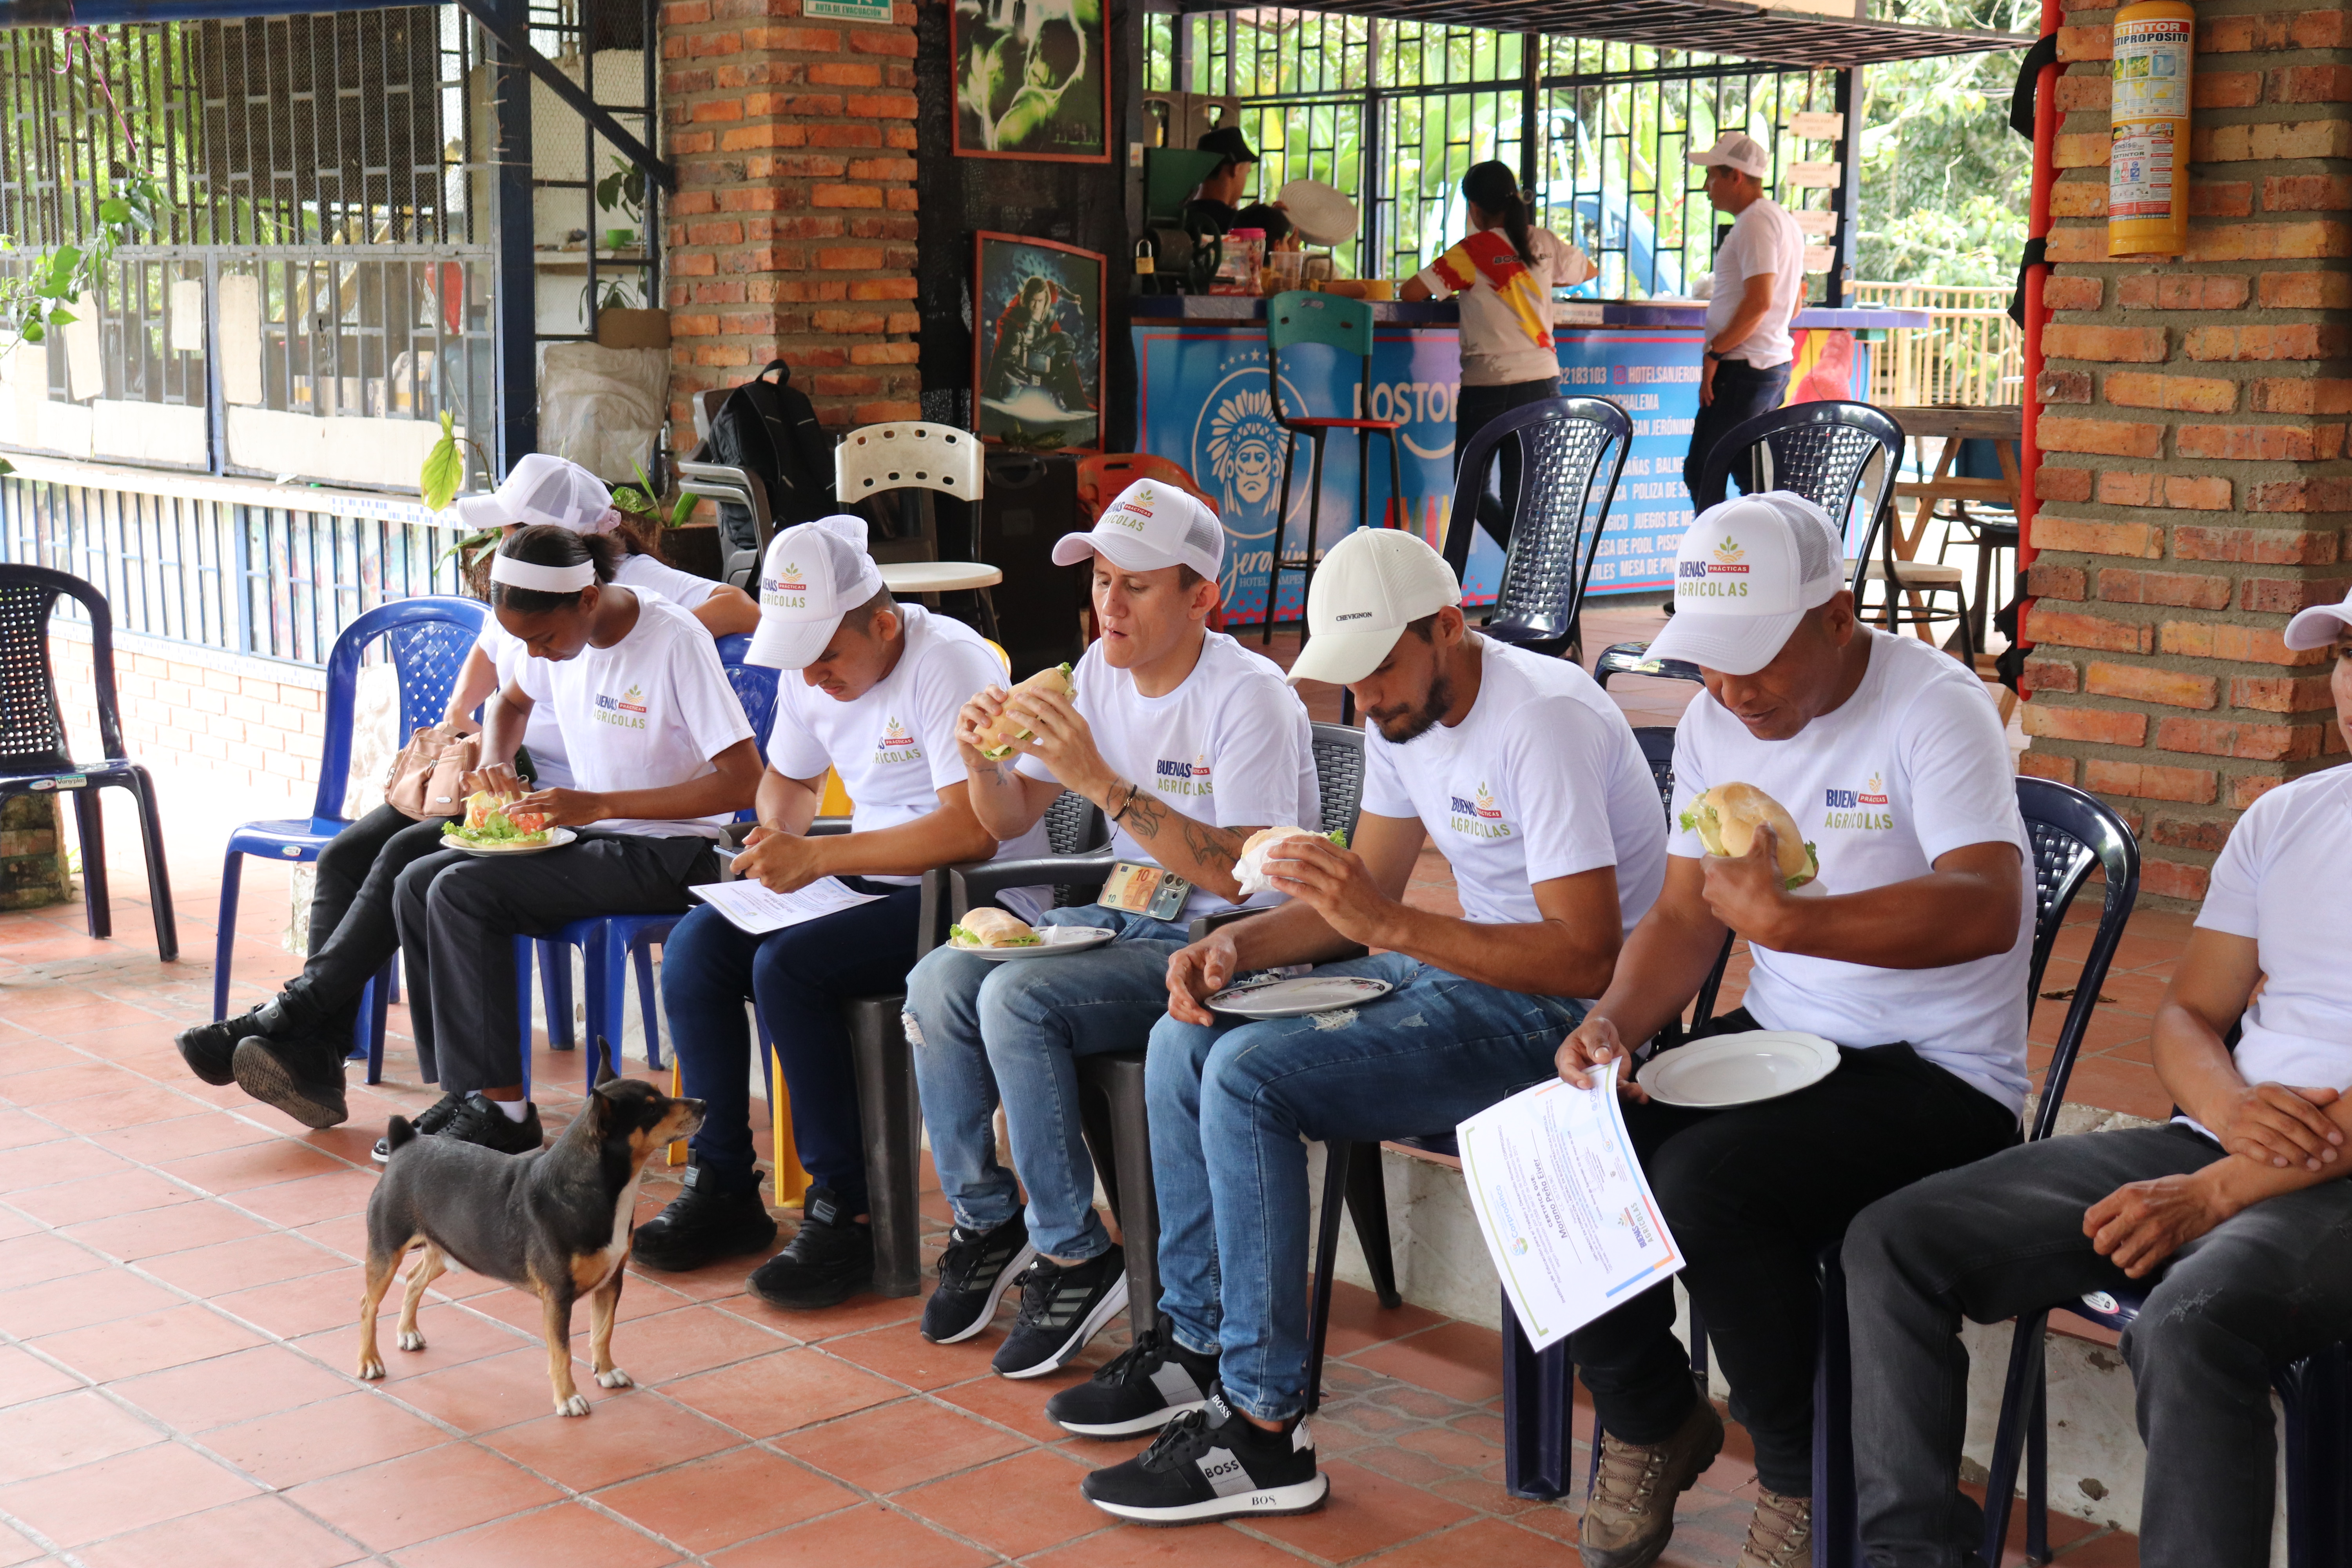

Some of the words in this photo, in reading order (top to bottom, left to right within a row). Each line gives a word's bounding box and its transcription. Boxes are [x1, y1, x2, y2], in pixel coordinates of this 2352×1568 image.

[816, 3, 831, 11] RUTA
[843, 6, 881, 16] EVACUACIÓN
[1656, 456, 1685, 474] BALNE
[1632, 483, 1664, 500] POLIZA
[1666, 482, 1677, 498] DE
[1125, 505, 1151, 516] PRÁCTICAS
[1633, 512, 1666, 530] JUEGOS
[1668, 511, 1679, 527] DE
[1617, 538, 1630, 555] DE
[1630, 537, 1654, 554] POOL
[1620, 559, 1645, 577] MESA
[1647, 558, 1659, 575] DE
[1679, 561, 1706, 577] BUENAS
[1240, 577, 1269, 587] HOTEL
[1278, 574, 1306, 585] AMPES
[1678, 578, 1748, 597] AGRÍCOLAS
[761, 591, 805, 608] AGRÍCOLAS
[1336, 612, 1372, 621] CHEVIGNON
[595, 693, 618, 711] BUENAS
[593, 708, 645, 729] AGRÍCOLAS
[873, 749, 921, 764] RÍCOLAS
[1157, 759, 1192, 778] BUENAS
[1158, 778, 1213, 796] AGRÍCLAS
[1451, 796, 1477, 817] BUENAS
[1826, 789, 1859, 808] BUENA
[1451, 816, 1511, 838] AGRÍCOLAS
[1824, 808, 1893, 829] AGRÍCOLAS
[1136, 869, 1150, 882] 10
[1108, 894, 1116, 903] 10
[1505, 1160, 1514, 1181] Humano
[1532, 1158, 1544, 1180] Eiver
[1529, 1174, 1539, 1191] QUE:
[1539, 1180, 1553, 1202] Peña
[1512, 1181, 1524, 1207] Desarrollo
[1494, 1184, 1519, 1238] Corprodinco
[1535, 1191, 1553, 1228] CERTIFICA
[1522, 1211, 1533, 1230] Trabajo
[1548, 1203, 1568, 1239] Morano
[1630, 1202, 1654, 1243] AGRÍCOLAS
[1532, 1236, 1540, 1248] para
[1631, 1225, 1647, 1248] BUENAS
[1537, 1248, 1552, 1274] Educación
[1553, 1282, 1566, 1303] Instituto
[1212, 1394, 1232, 1418] BOSS
[1205, 1460, 1239, 1478] BOSS
